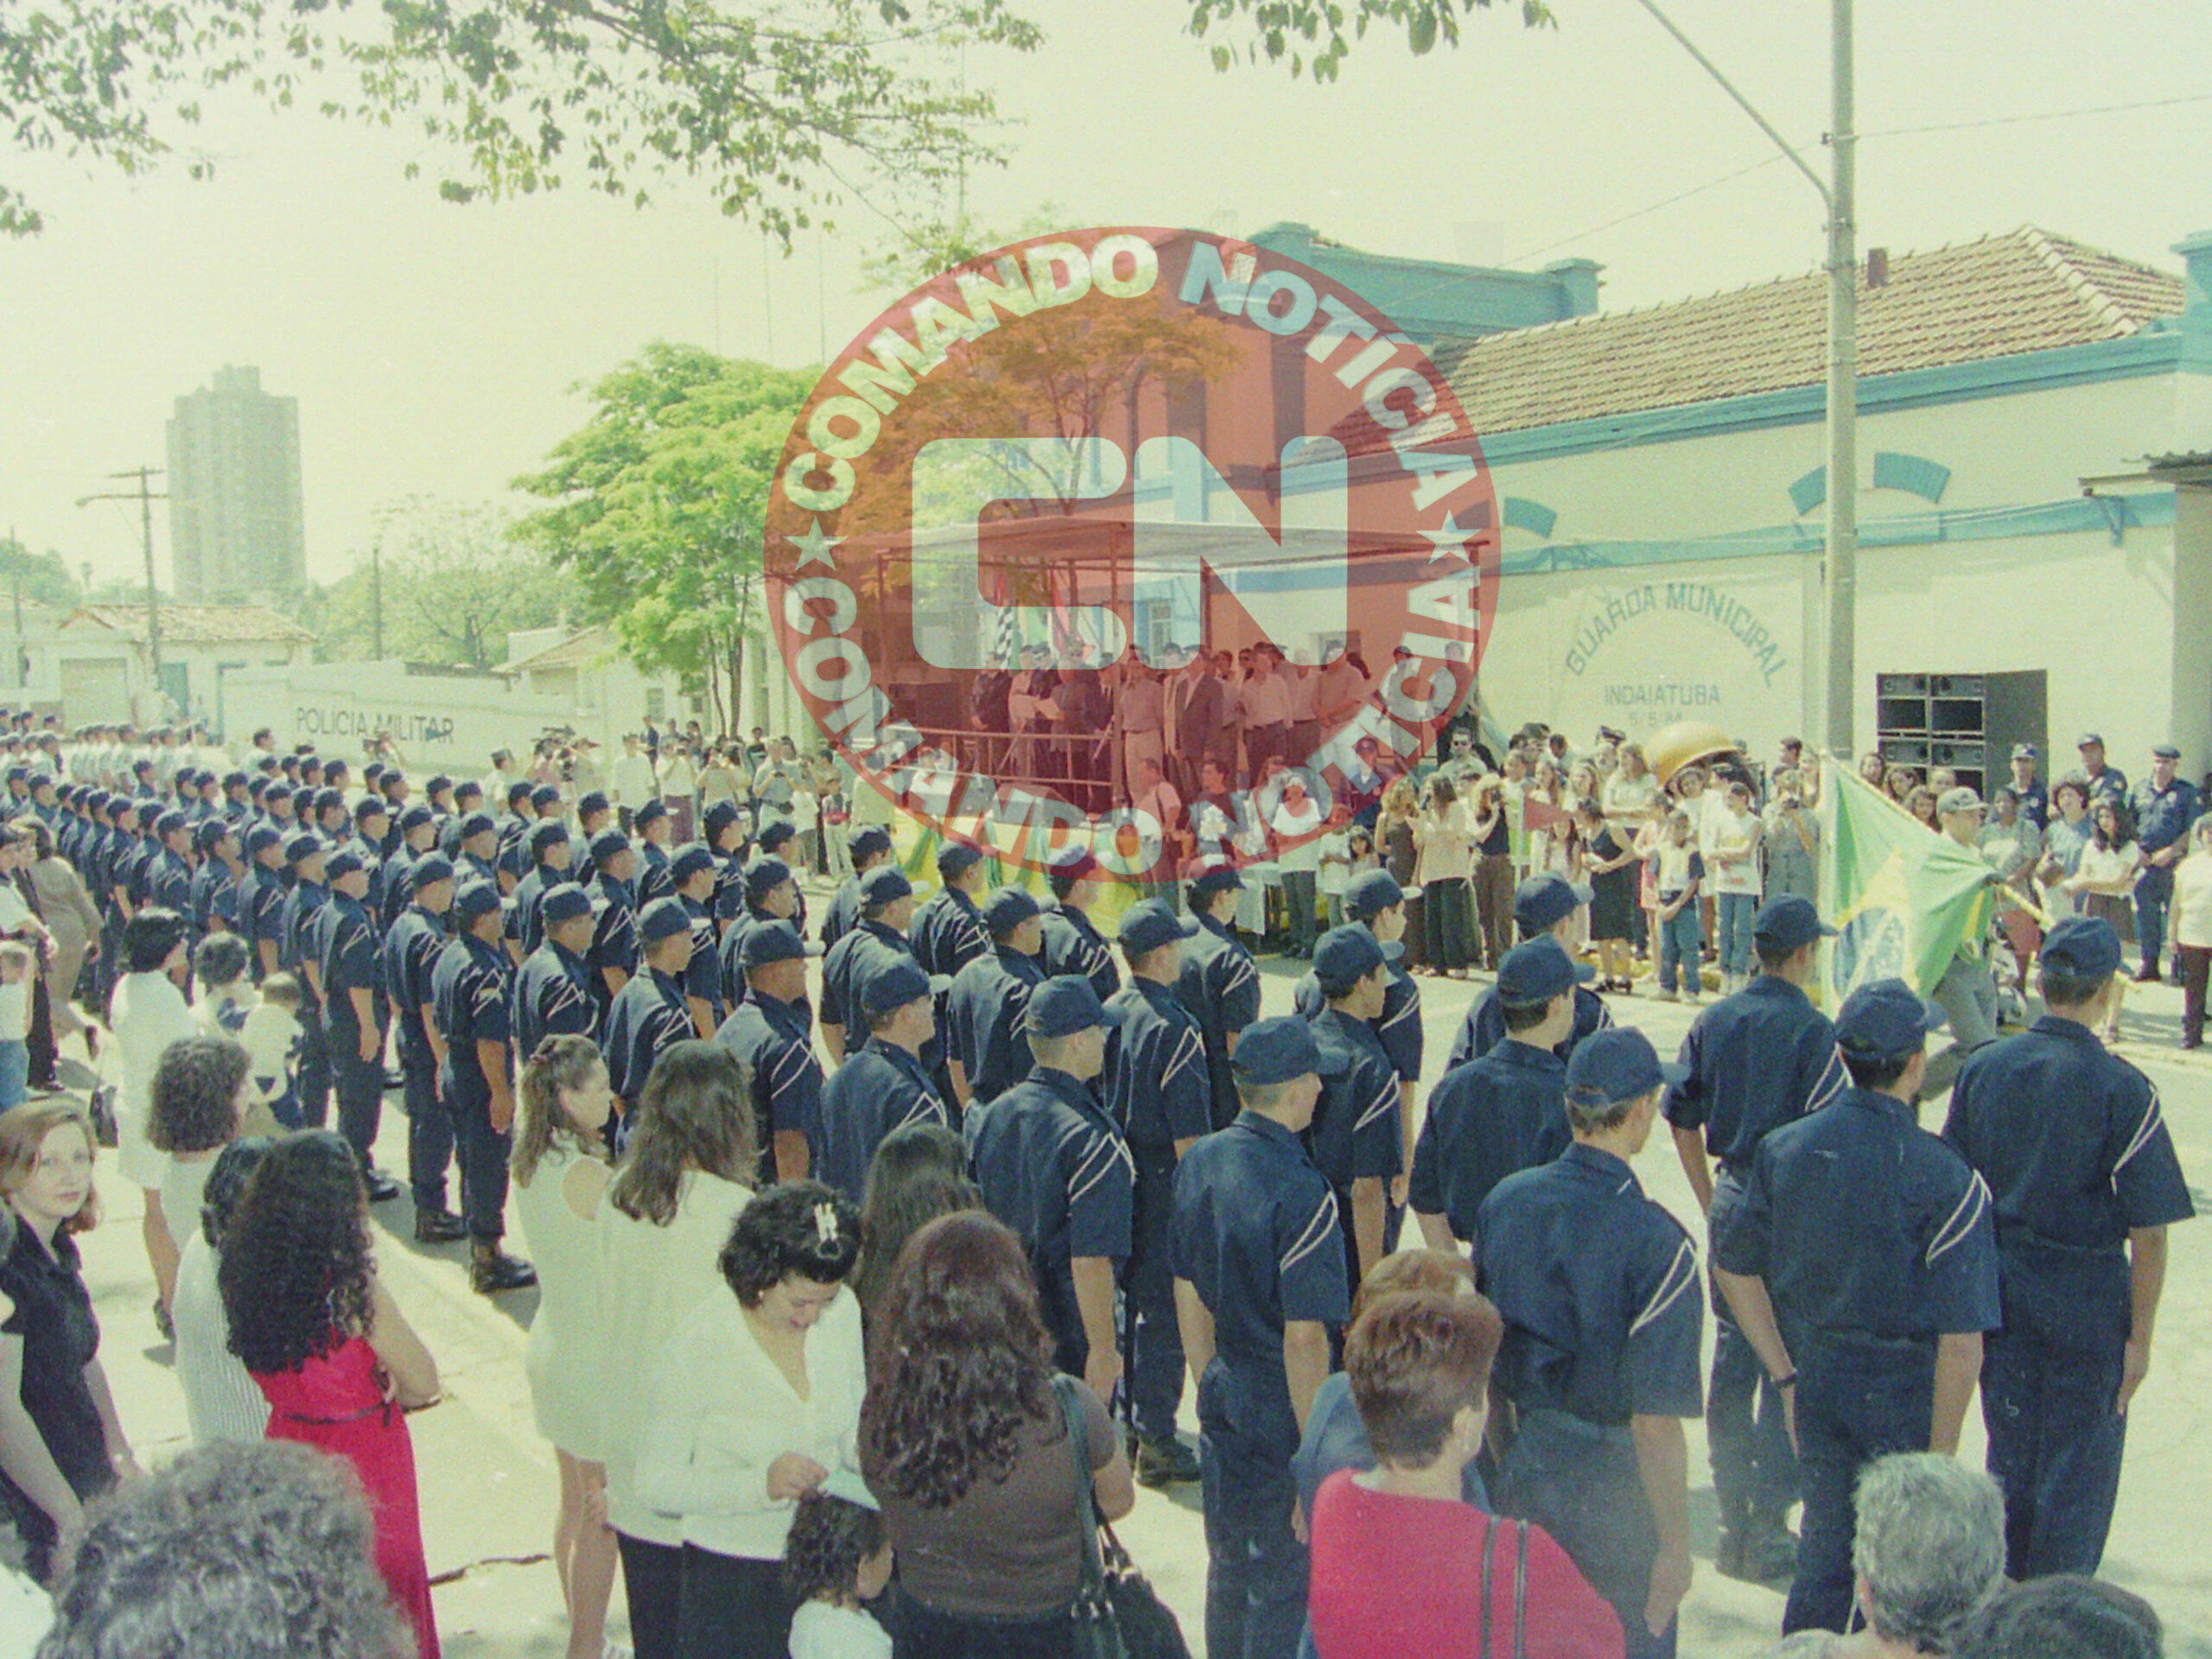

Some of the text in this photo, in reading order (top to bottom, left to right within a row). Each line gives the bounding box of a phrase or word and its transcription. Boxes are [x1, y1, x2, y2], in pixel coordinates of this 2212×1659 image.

[1566, 582, 1786, 688] GUARDA MUNICIPAL
[1605, 684, 1719, 705] INDAIATUBA
[373, 714, 454, 744] MILITAR
